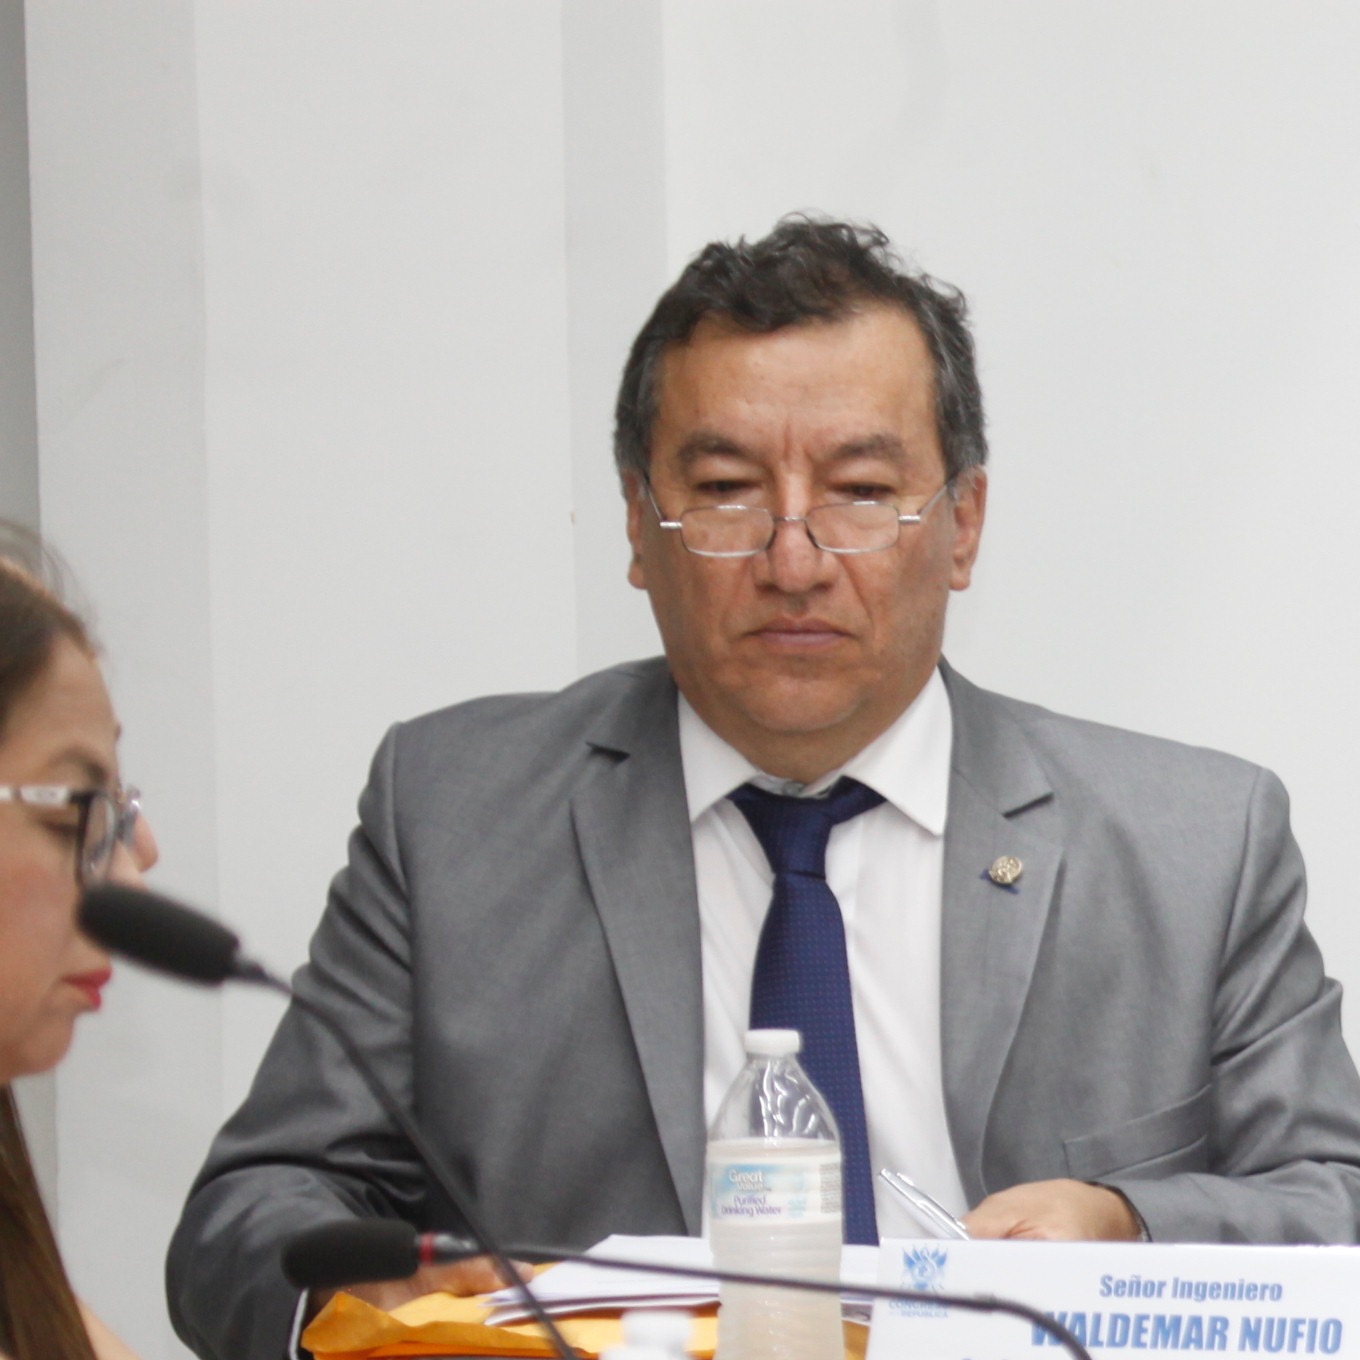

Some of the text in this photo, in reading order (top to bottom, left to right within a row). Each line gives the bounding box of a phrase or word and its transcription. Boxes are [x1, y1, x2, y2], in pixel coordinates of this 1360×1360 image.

[729, 1169, 764, 1183] Great
[733, 1195, 767, 1206] Purified
[721, 1205, 782, 1217] Drinking Water
[1100, 1274, 1282, 1302] Señor Ingeniero
[1031, 1311, 1343, 1355] WALDEMAR NUFIO
